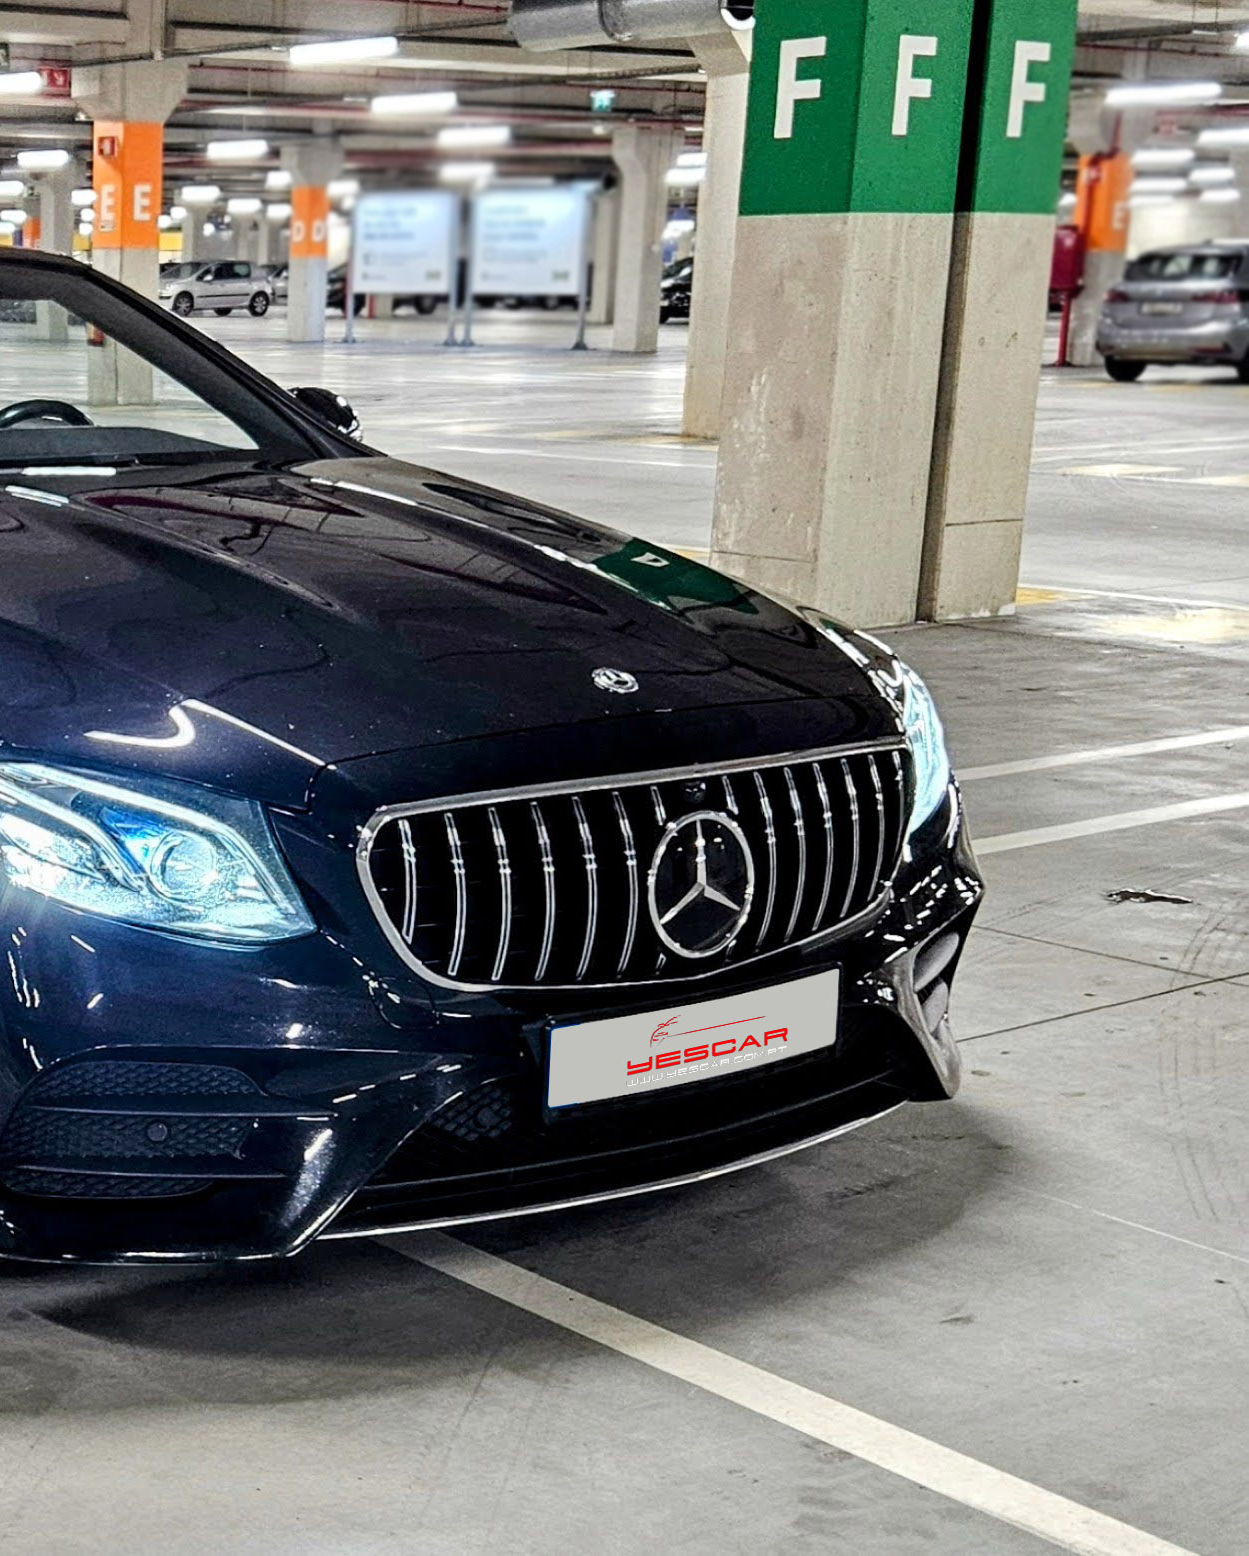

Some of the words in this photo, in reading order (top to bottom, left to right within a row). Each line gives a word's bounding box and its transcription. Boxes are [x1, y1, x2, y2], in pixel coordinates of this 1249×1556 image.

[774, 36, 827, 139] F
[891, 34, 938, 136] F
[1006, 40, 1051, 138] F
[101, 184, 114, 220] E
[134, 184, 151, 220] E
